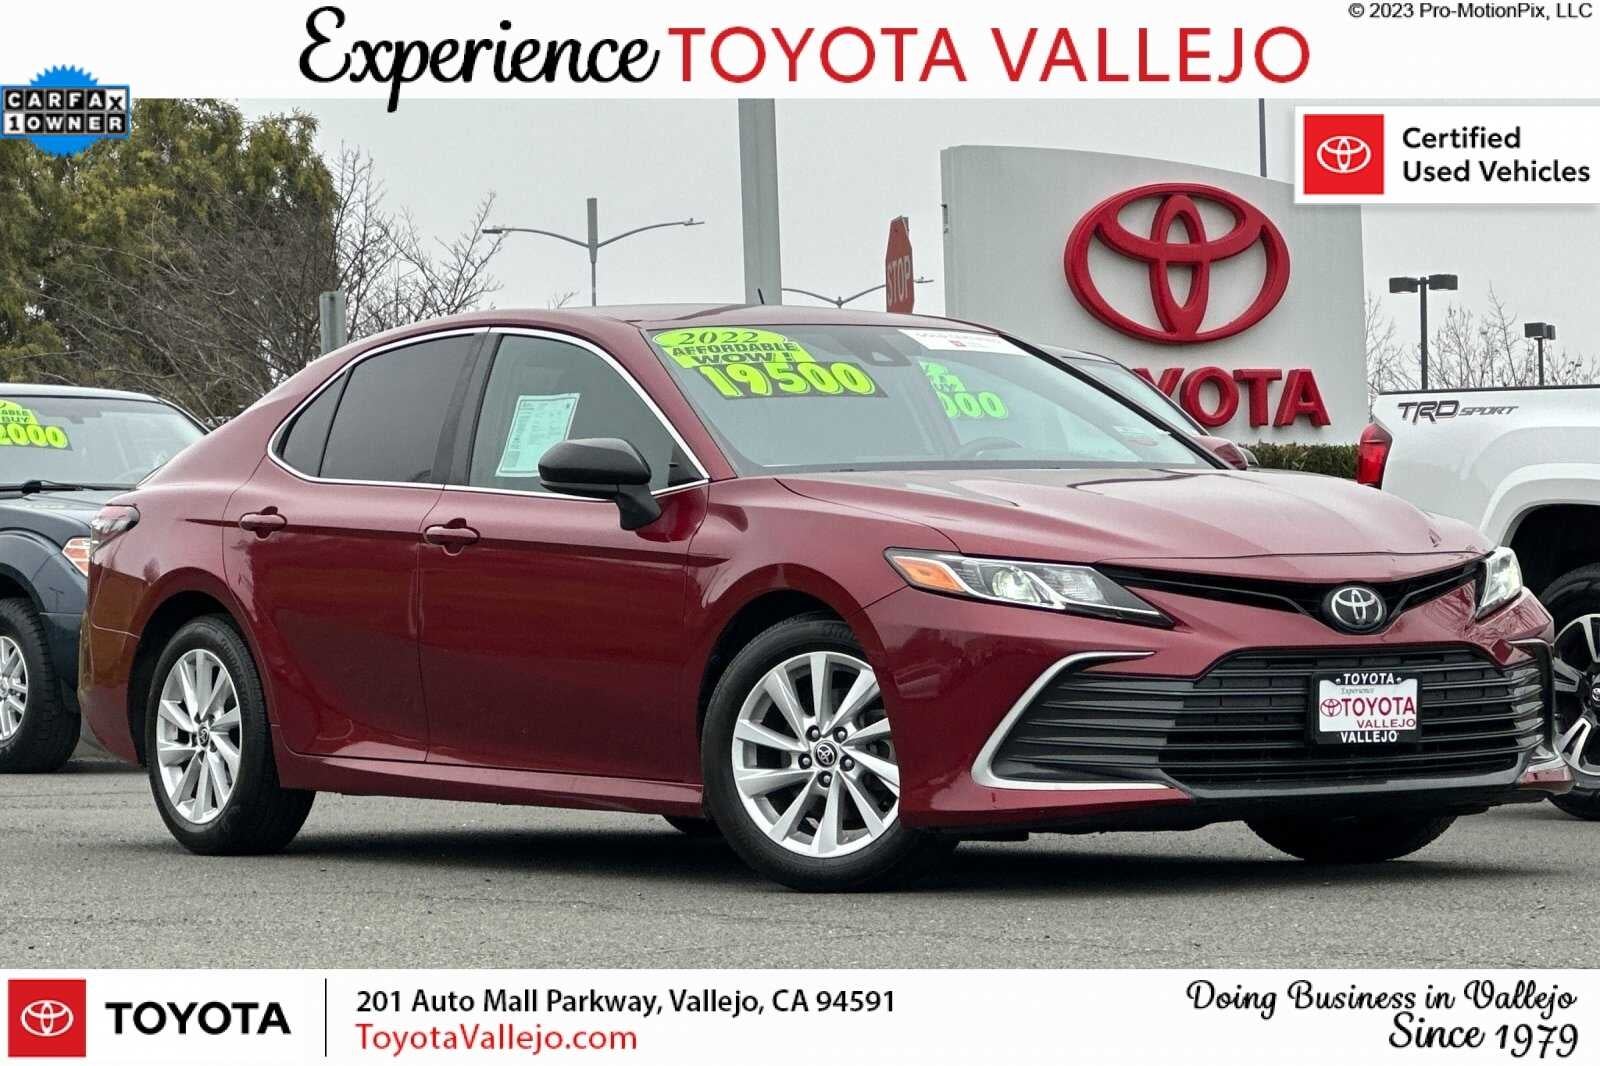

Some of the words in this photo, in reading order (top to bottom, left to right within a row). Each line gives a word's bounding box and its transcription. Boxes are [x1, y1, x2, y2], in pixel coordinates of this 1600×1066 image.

[887, 255, 911, 307] STOP
[679, 331, 759, 345] 2022
[673, 341, 796, 356] AFFORDABLE
[700, 362, 876, 397] 19500
[1397, 400, 1460, 425] TRD
[1459, 406, 1519, 416] SPORT
[1343, 673, 1395, 685] TOYOTA
[1341, 697, 1416, 716] TOYOTA
[1356, 718, 1416, 729] VALLEJO
[1340, 730, 1398, 743] VALLEJO
